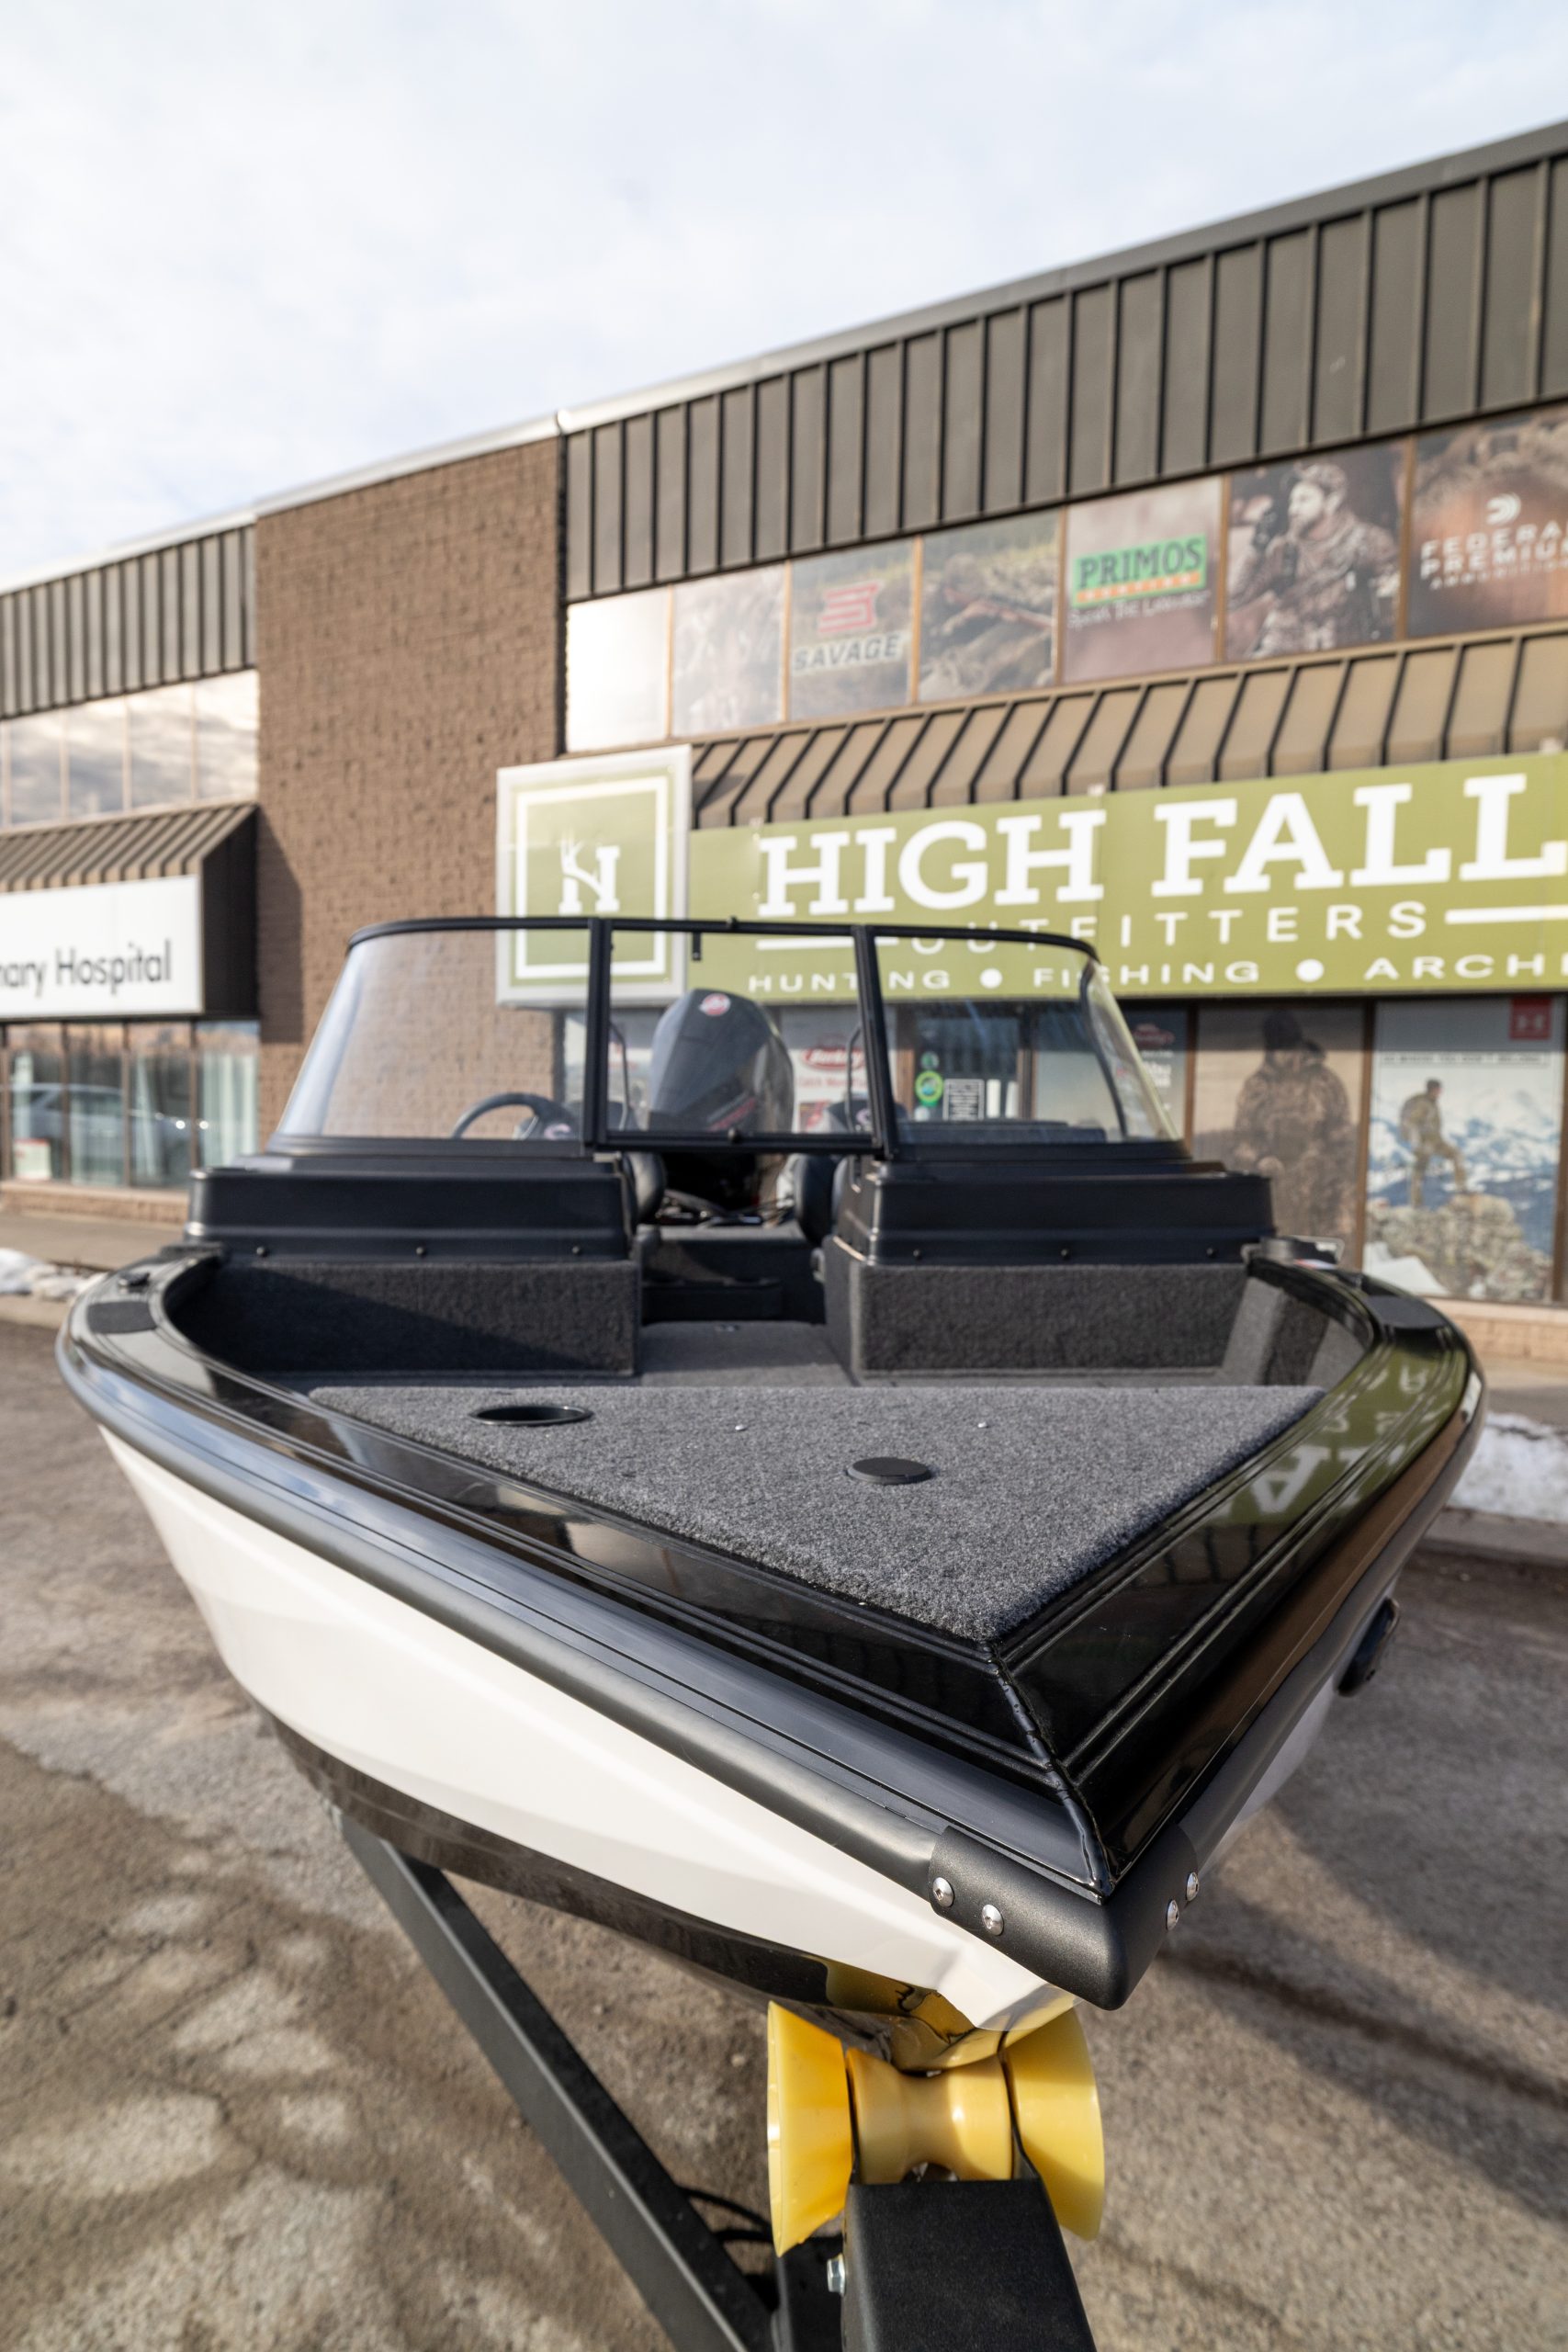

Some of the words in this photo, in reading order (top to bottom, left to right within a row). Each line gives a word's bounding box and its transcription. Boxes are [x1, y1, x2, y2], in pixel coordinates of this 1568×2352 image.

[1419, 521, 1568, 559] FEDERA
[1078, 538, 1201, 589] PRIMOS
[794, 632, 900, 672] SAVAGE
[758, 808, 1106, 917] HIGH
[1151, 774, 1568, 897] FALL
[0, 961, 46, 999] ary
[55, 938, 172, 995] Hospital
[749, 970, 951, 992] HUNTNG
[1364, 953, 1568, 981] ARCH
